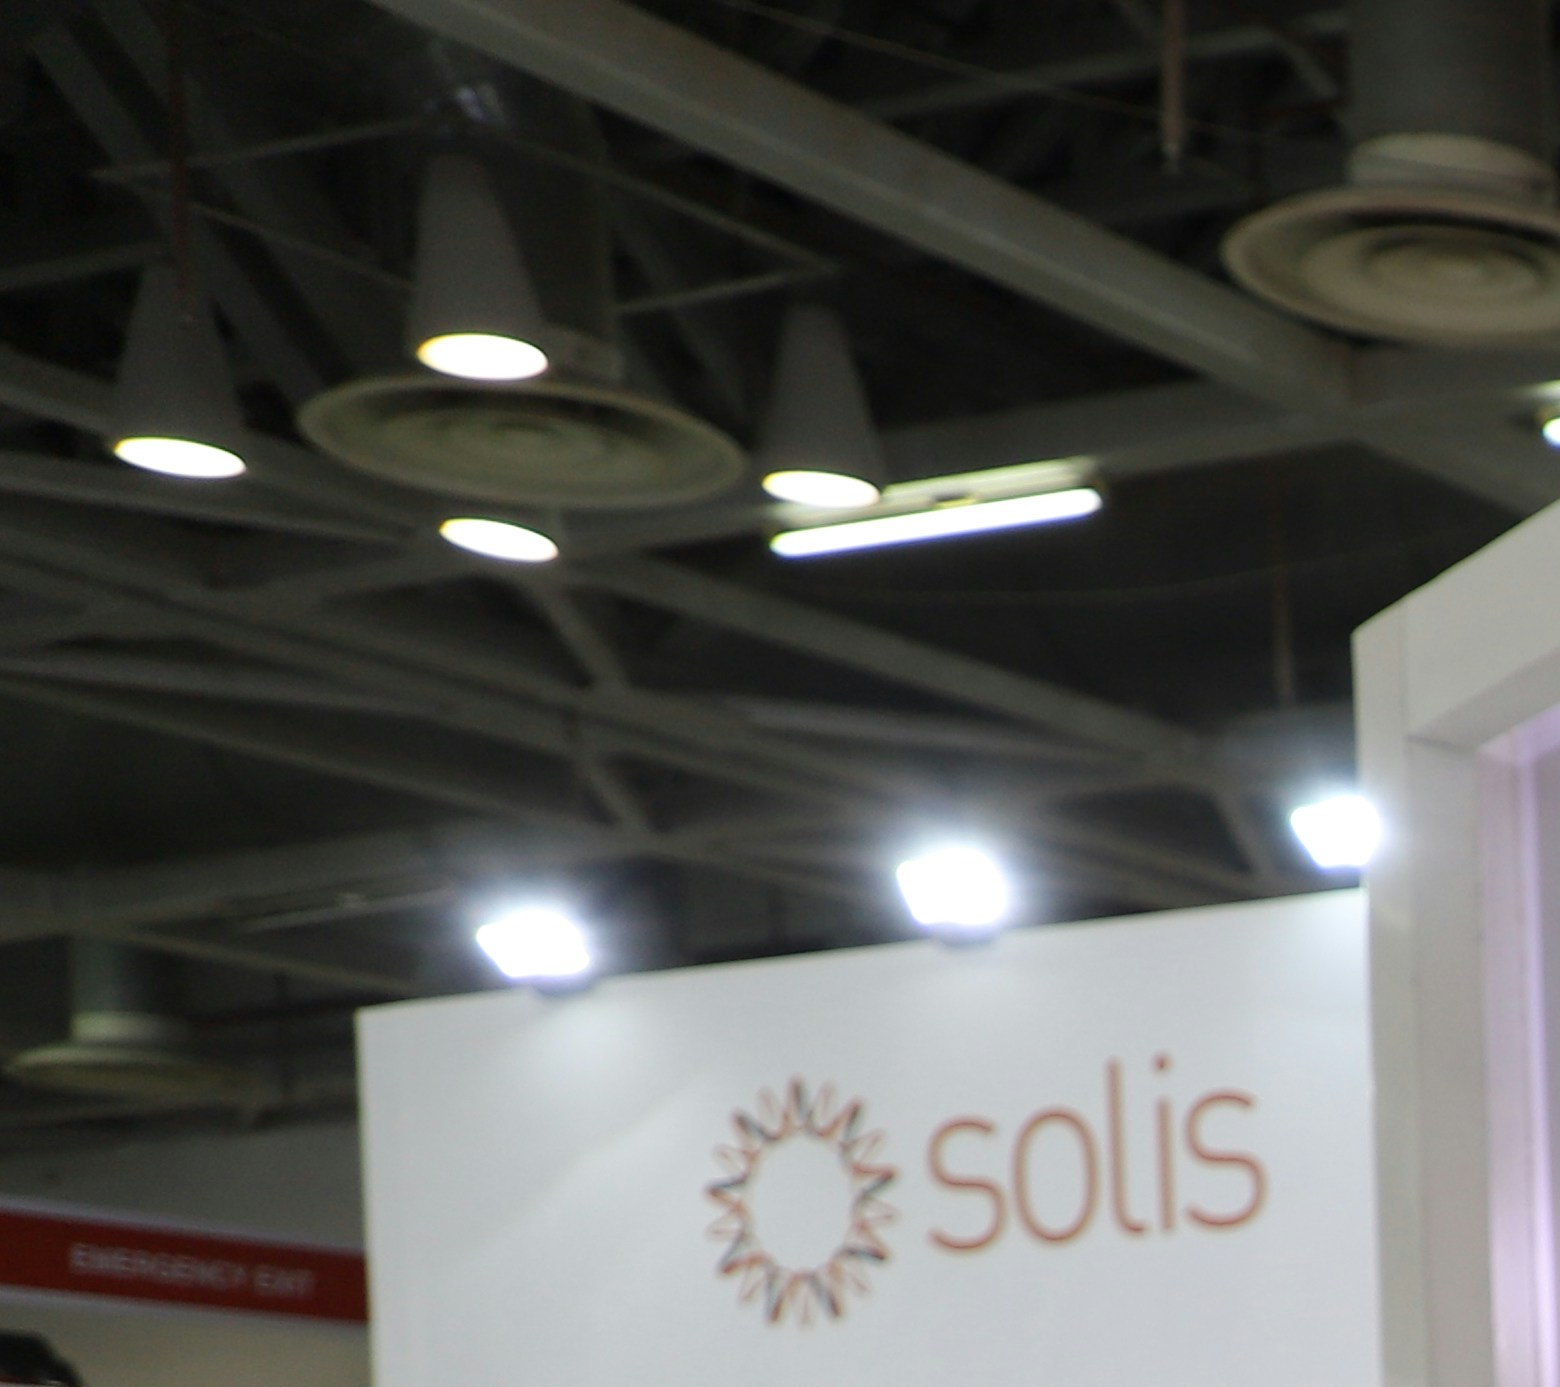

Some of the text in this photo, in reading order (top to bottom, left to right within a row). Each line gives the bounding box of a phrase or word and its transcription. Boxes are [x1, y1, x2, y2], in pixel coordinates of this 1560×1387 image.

[926, 1050, 1271, 1253] solis
[69, 1242, 316, 1300] EMERGENCY EXIT
